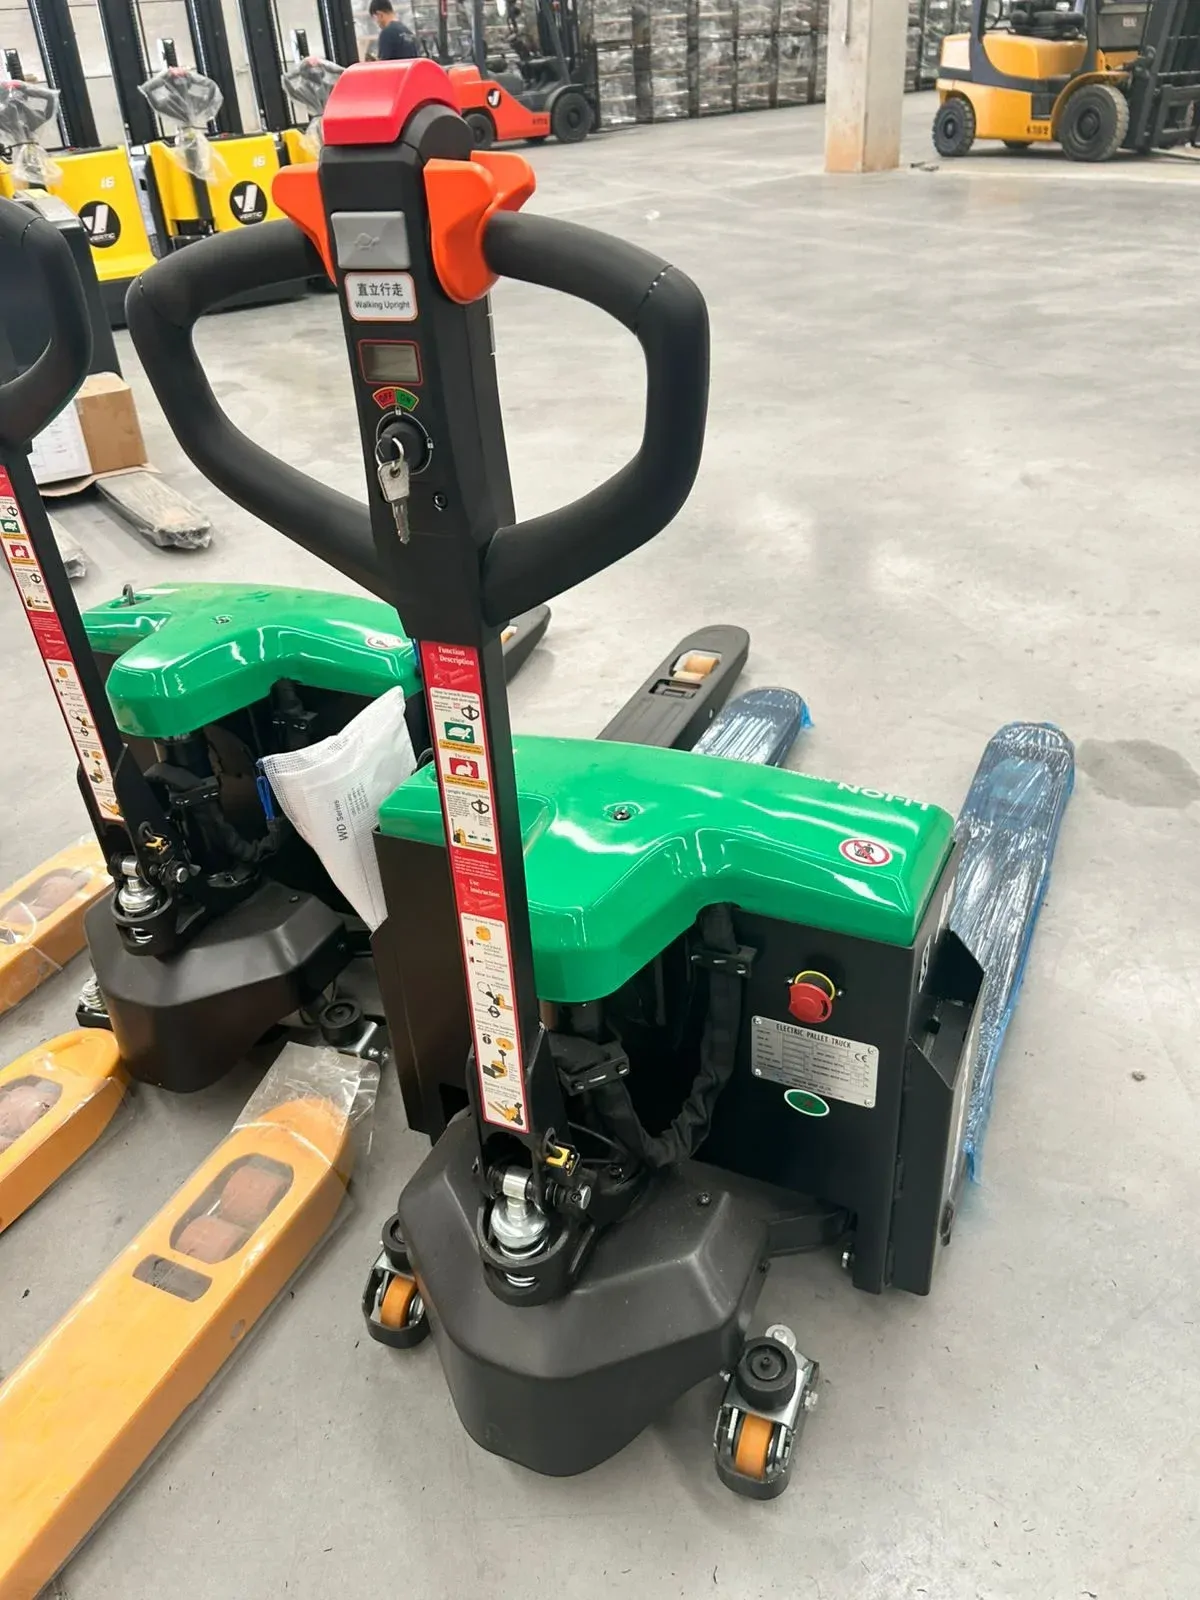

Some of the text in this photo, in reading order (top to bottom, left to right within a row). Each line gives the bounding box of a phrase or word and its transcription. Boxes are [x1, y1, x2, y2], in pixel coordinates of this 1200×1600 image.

[357, 282, 404, 297] 直立行走
[354, 300, 410, 311] Walking Upright
[438, 646, 465, 657] Function
[439, 654, 475, 667] Description
[334, 799, 349, 841] WD Series
[776, 1023, 851, 1049] ELECTRIC PALLET TRUCK
